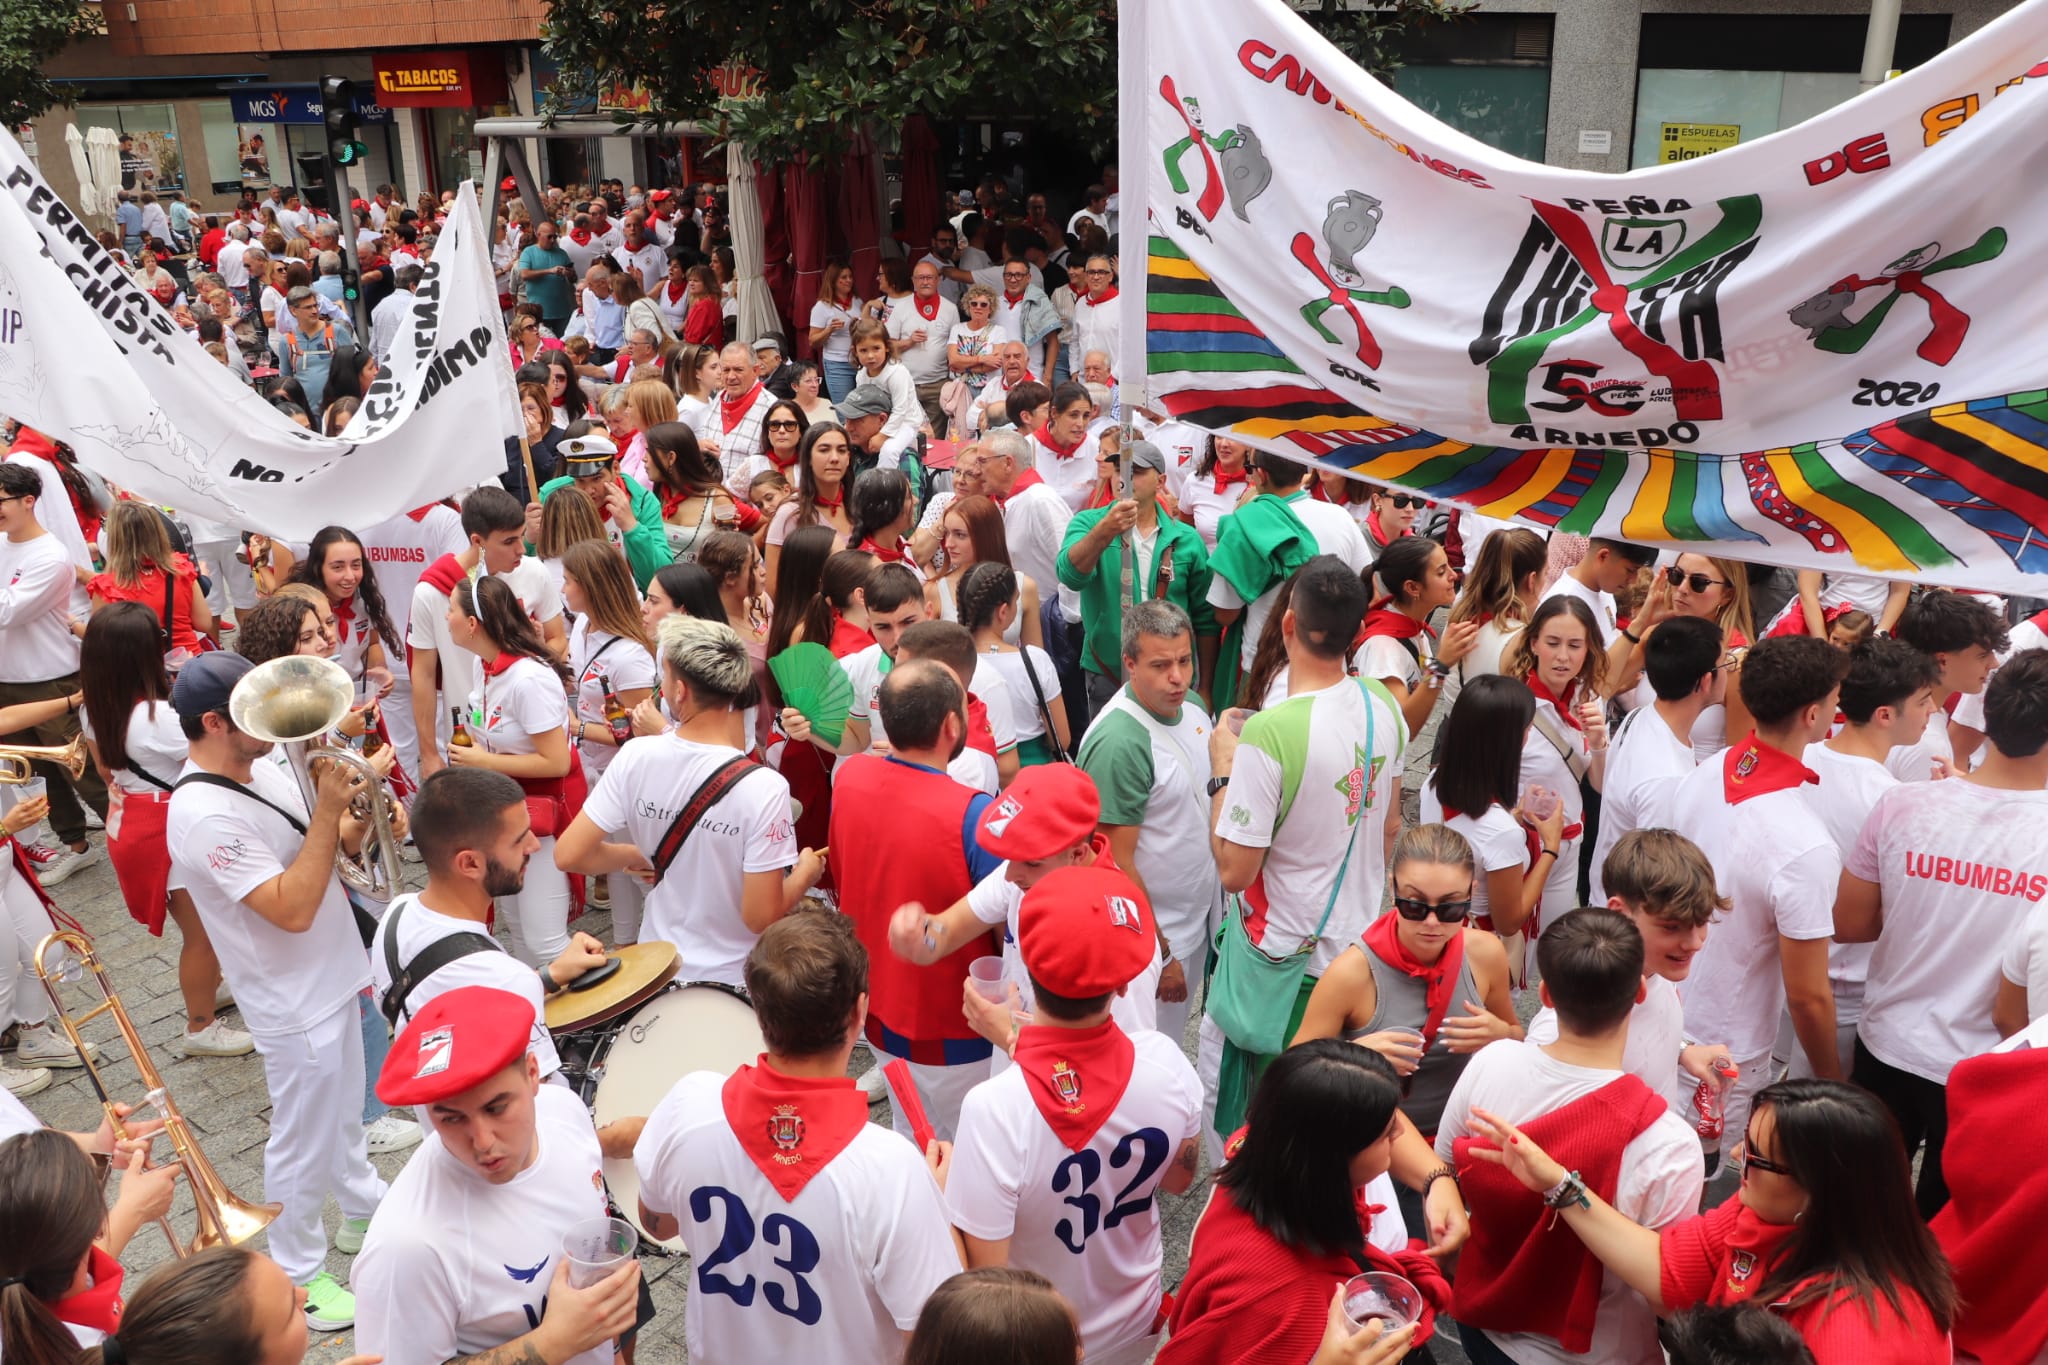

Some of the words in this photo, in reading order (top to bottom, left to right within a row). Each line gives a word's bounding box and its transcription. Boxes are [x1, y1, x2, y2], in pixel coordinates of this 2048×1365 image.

[396, 69, 458, 86] TABACOS
[249, 101, 276, 117] MGS
[1681, 127, 1736, 138] ESPUELAS
[1803, 132, 1891, 186] DE
[1562, 195, 1693, 216] PEÑA
[6, 164, 176, 336] PERMITAS
[1613, 227, 1663, 255] LA
[1851, 377, 1941, 407] 2020
[1510, 422, 1700, 448] ARNEDO
[228, 458, 286, 483] NO
[1905, 850, 2048, 904] LUBUMBAS
[772, 1152, 803, 1166] ARNEDO
[1051, 1126, 1171, 1256] 32
[689, 1185, 822, 1327] 23
